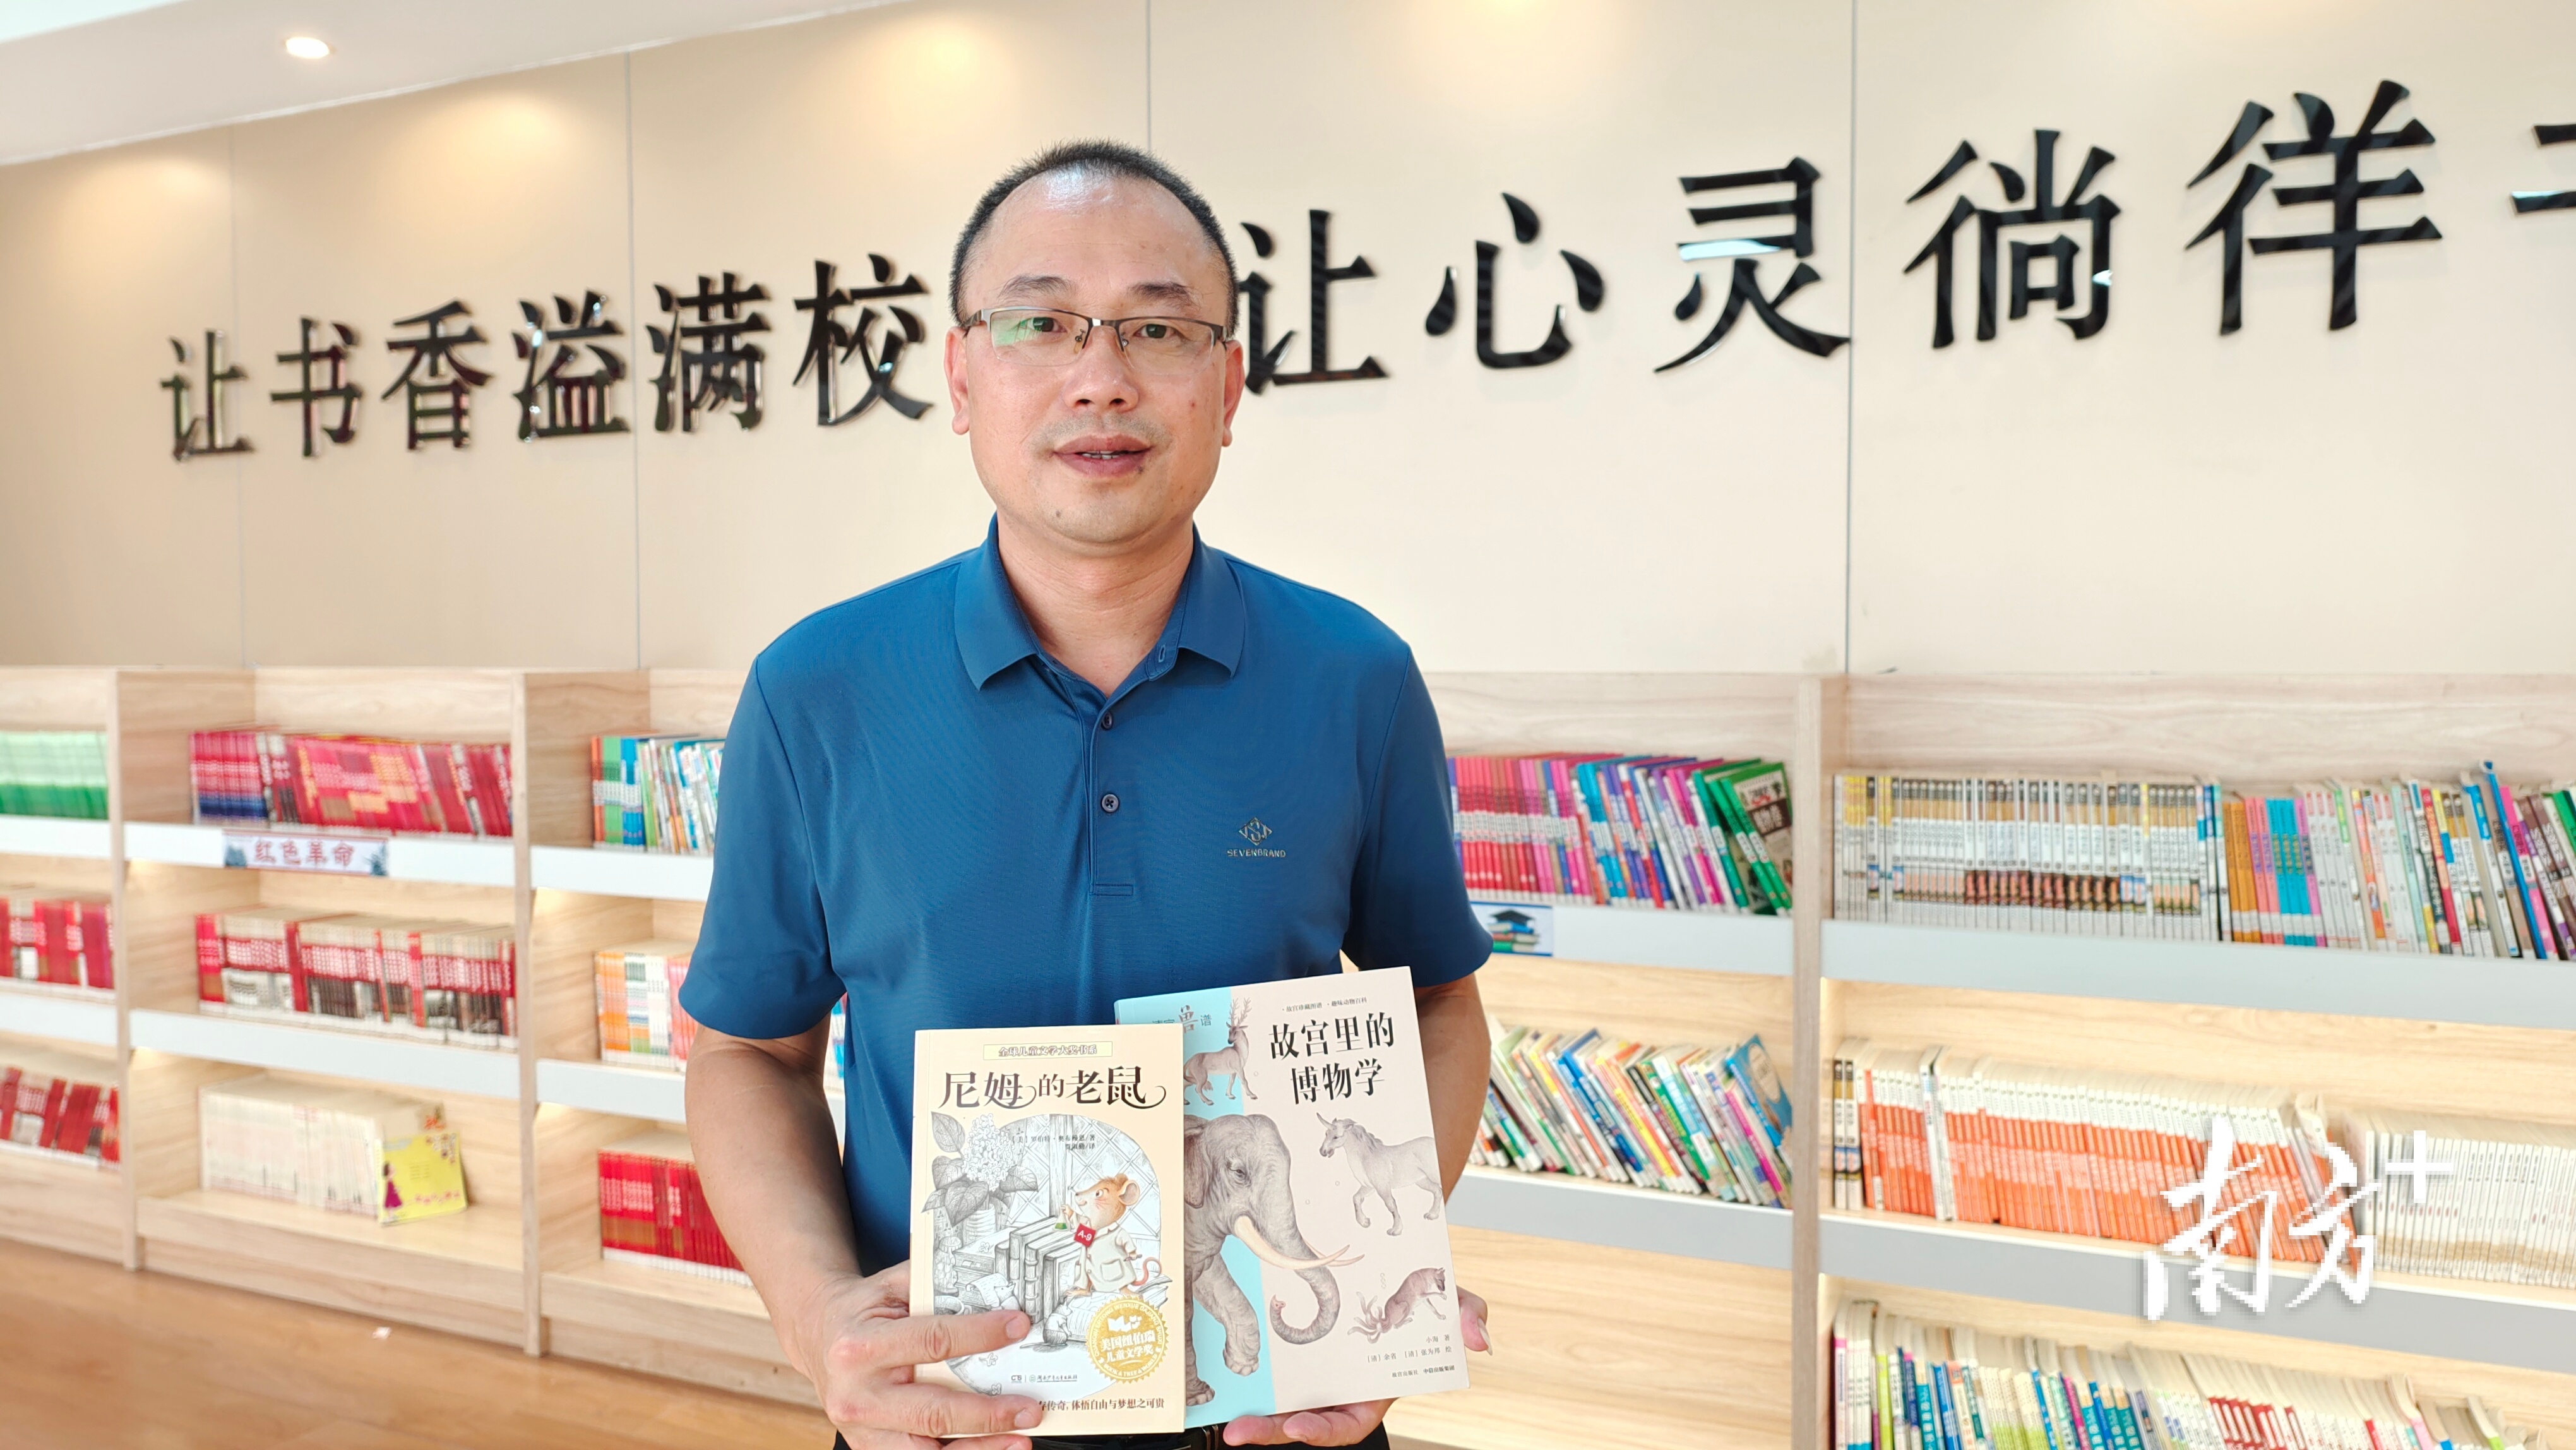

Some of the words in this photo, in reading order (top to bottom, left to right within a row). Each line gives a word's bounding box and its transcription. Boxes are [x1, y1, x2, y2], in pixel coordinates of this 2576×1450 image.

[254, 837, 355, 867] 红色革命
[1227, 849, 1286, 858] SEVENBRAND
[1268, 1012, 1395, 1060] 故宫里的
[998, 1045, 1098, 1057] 全球儿童文学大奖书系
[939, 1065, 1167, 1110] 尼姆的老鼠
[1291, 1058, 1385, 1105] 博物学
[1077, 1230, 1092, 1241] A-9
[1102, 1329, 1156, 1352] 美国纽伯瑞
[1107, 1344, 1154, 1363] 儿童文学奖
